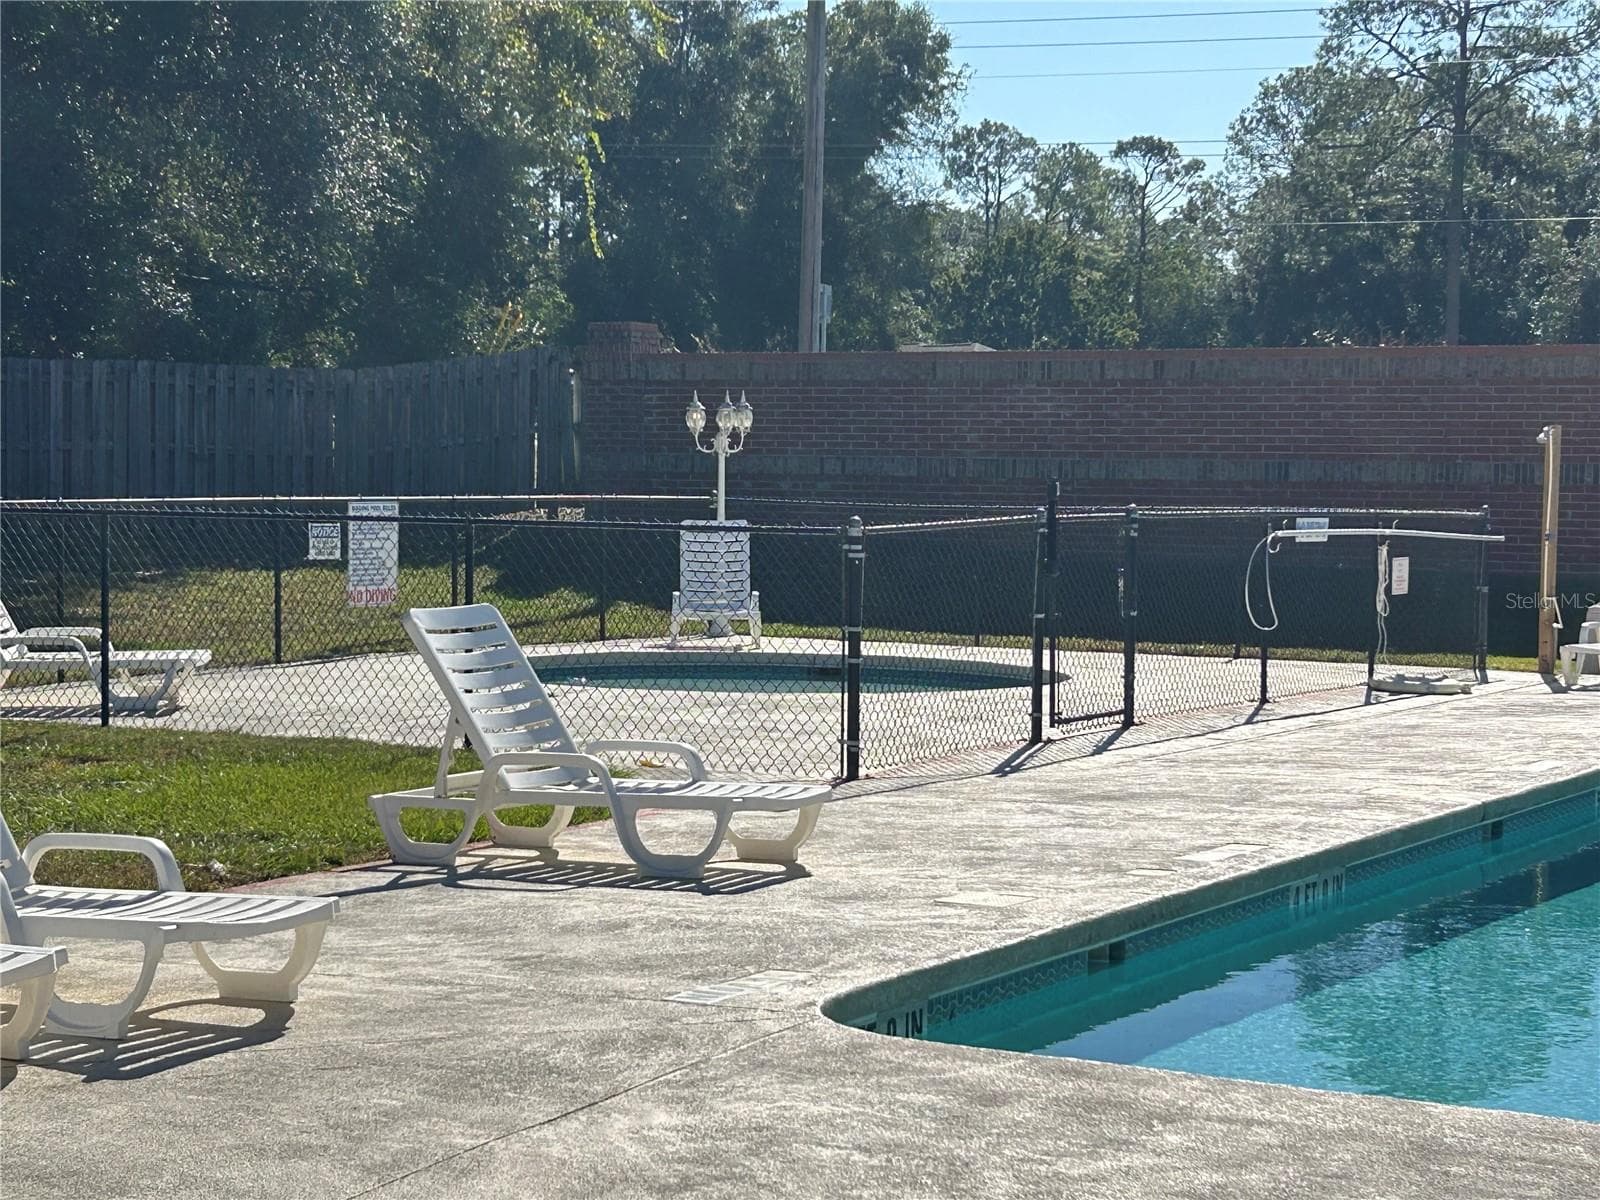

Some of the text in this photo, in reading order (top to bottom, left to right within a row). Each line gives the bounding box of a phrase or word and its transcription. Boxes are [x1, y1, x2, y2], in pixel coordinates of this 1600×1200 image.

[312, 526, 339, 537] NOTICE
[350, 589, 396, 603] NO DIVING
[1332, 873, 1343, 896] IN
[905, 1008, 923, 1038] IN
